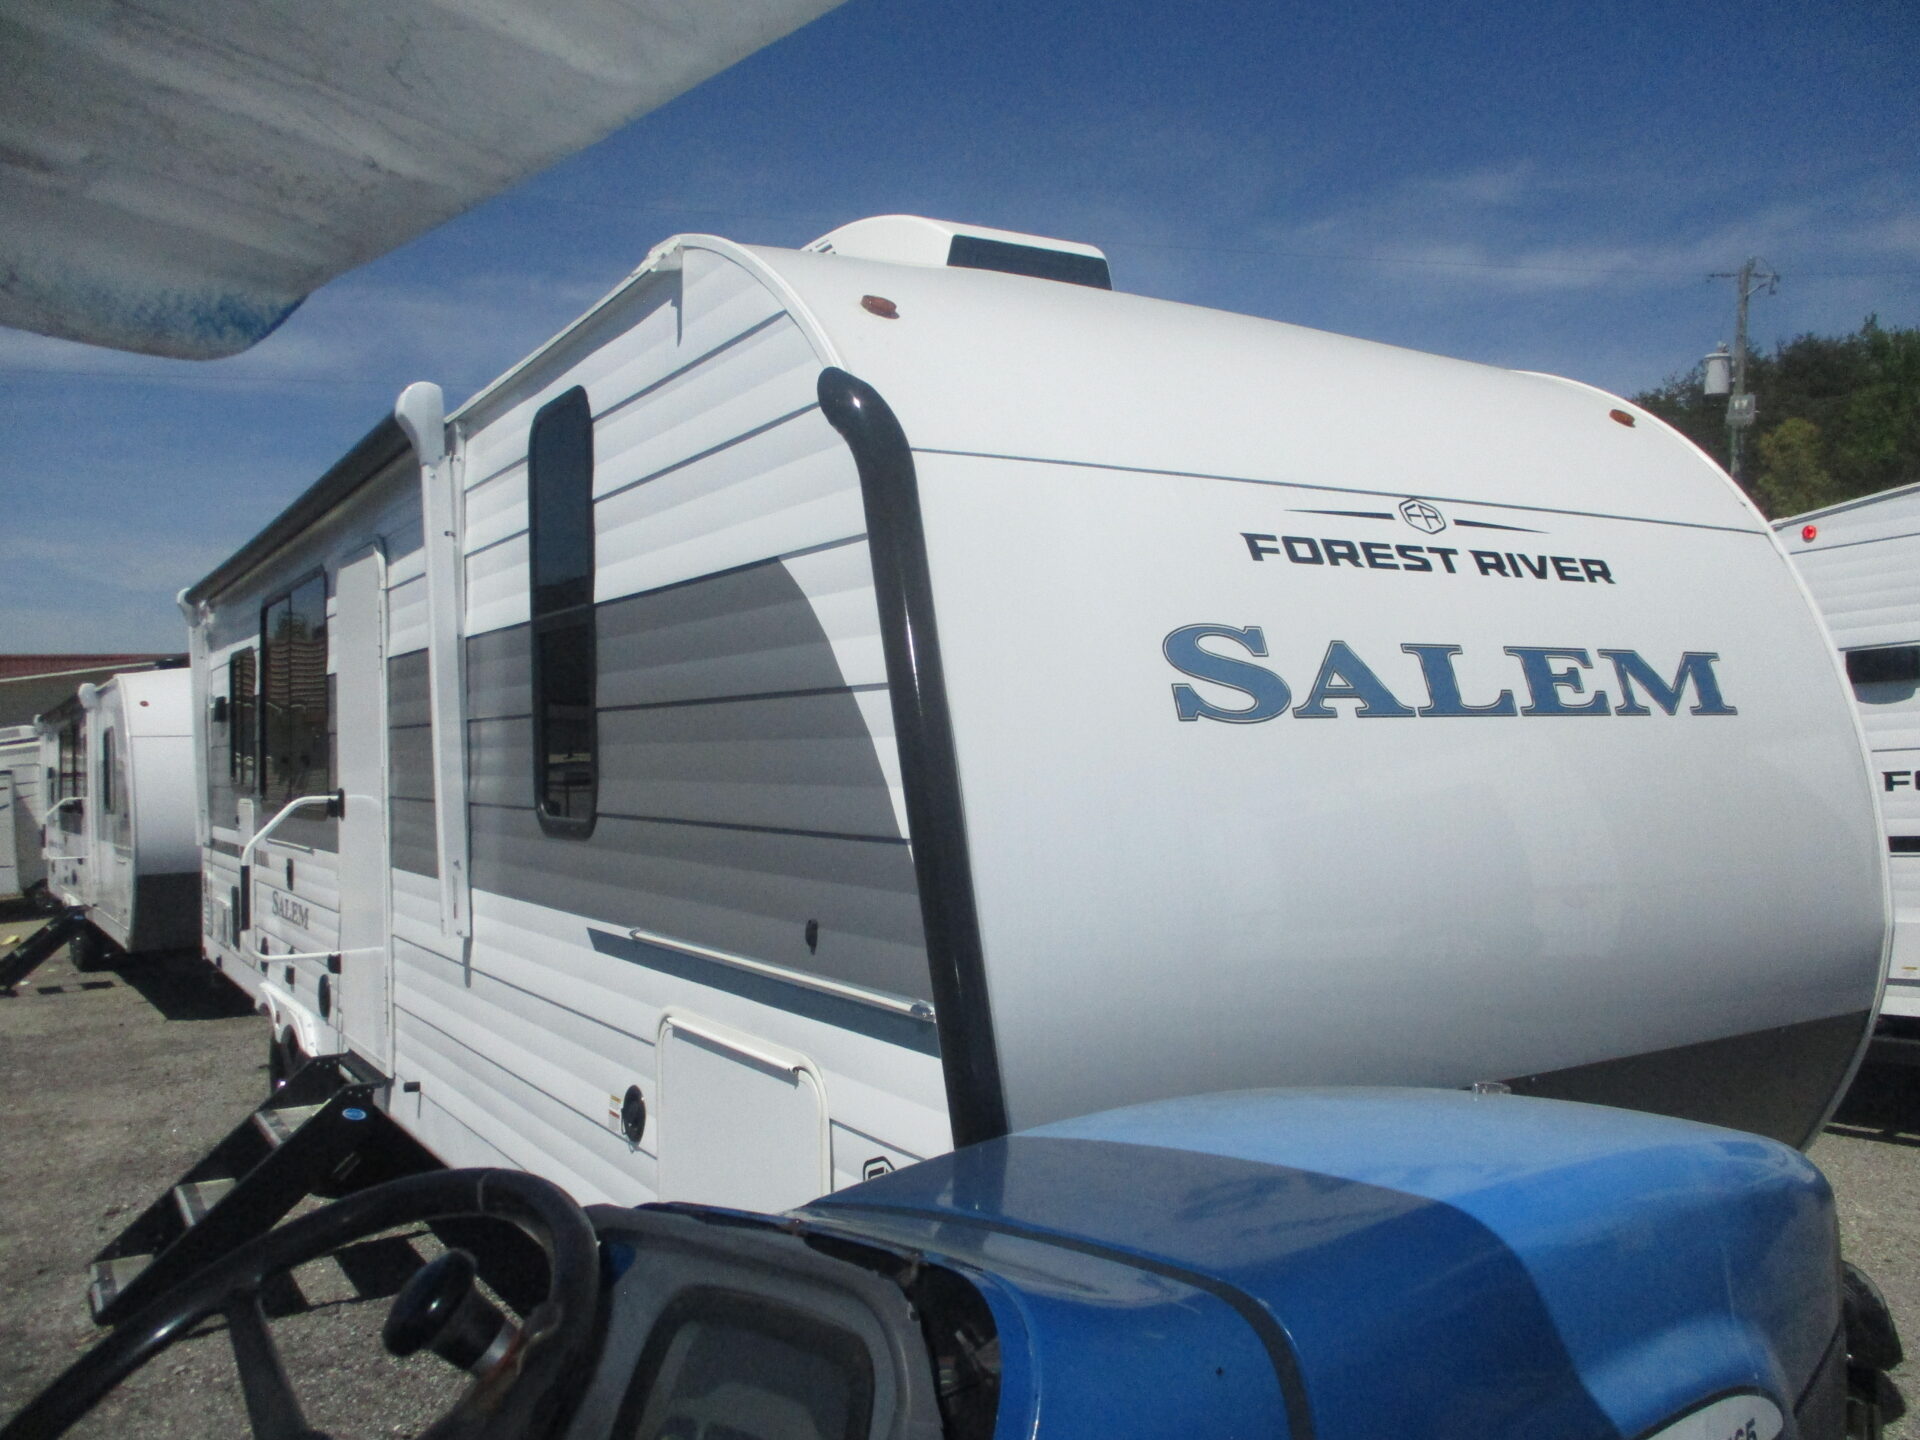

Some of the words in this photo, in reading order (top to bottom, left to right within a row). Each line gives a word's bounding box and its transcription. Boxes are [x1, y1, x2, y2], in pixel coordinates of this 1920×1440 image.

[1240, 532, 1458, 574] FOREST
[1468, 549, 1616, 584] RIVER
[1162, 623, 1738, 724] SALEM
[272, 890, 309, 930] SALEM
